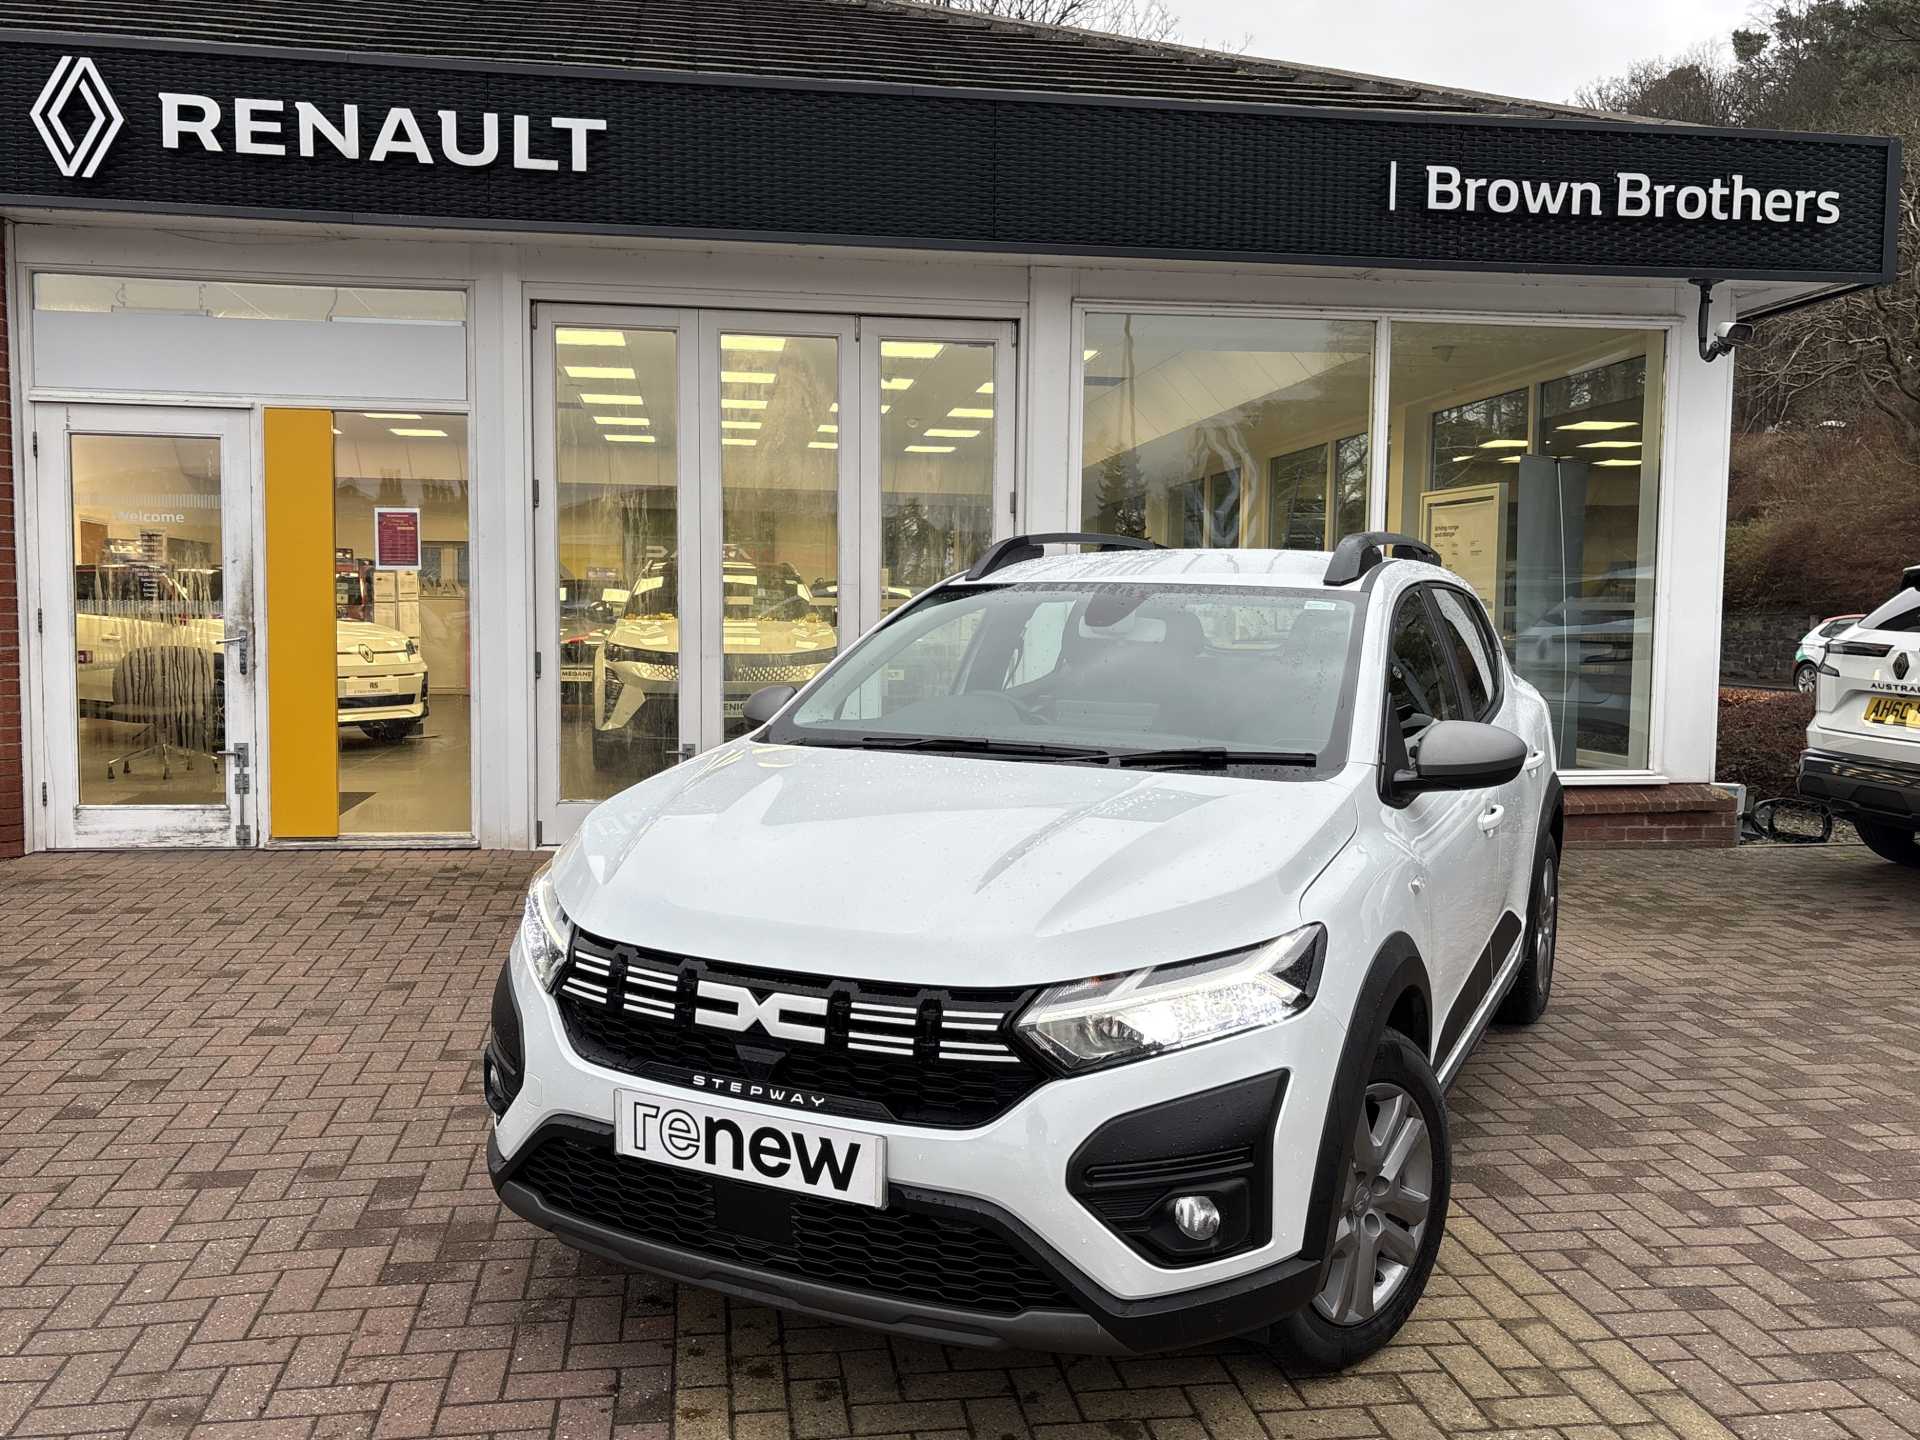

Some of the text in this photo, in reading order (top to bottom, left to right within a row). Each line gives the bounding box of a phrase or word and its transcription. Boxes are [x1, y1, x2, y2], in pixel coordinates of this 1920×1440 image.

[158, 92, 607, 172] RENAULT
[1426, 165, 1840, 225] Brown Brothers
[693, 1074, 825, 1107] STEPWAY
[633, 1101, 862, 1192] renew
